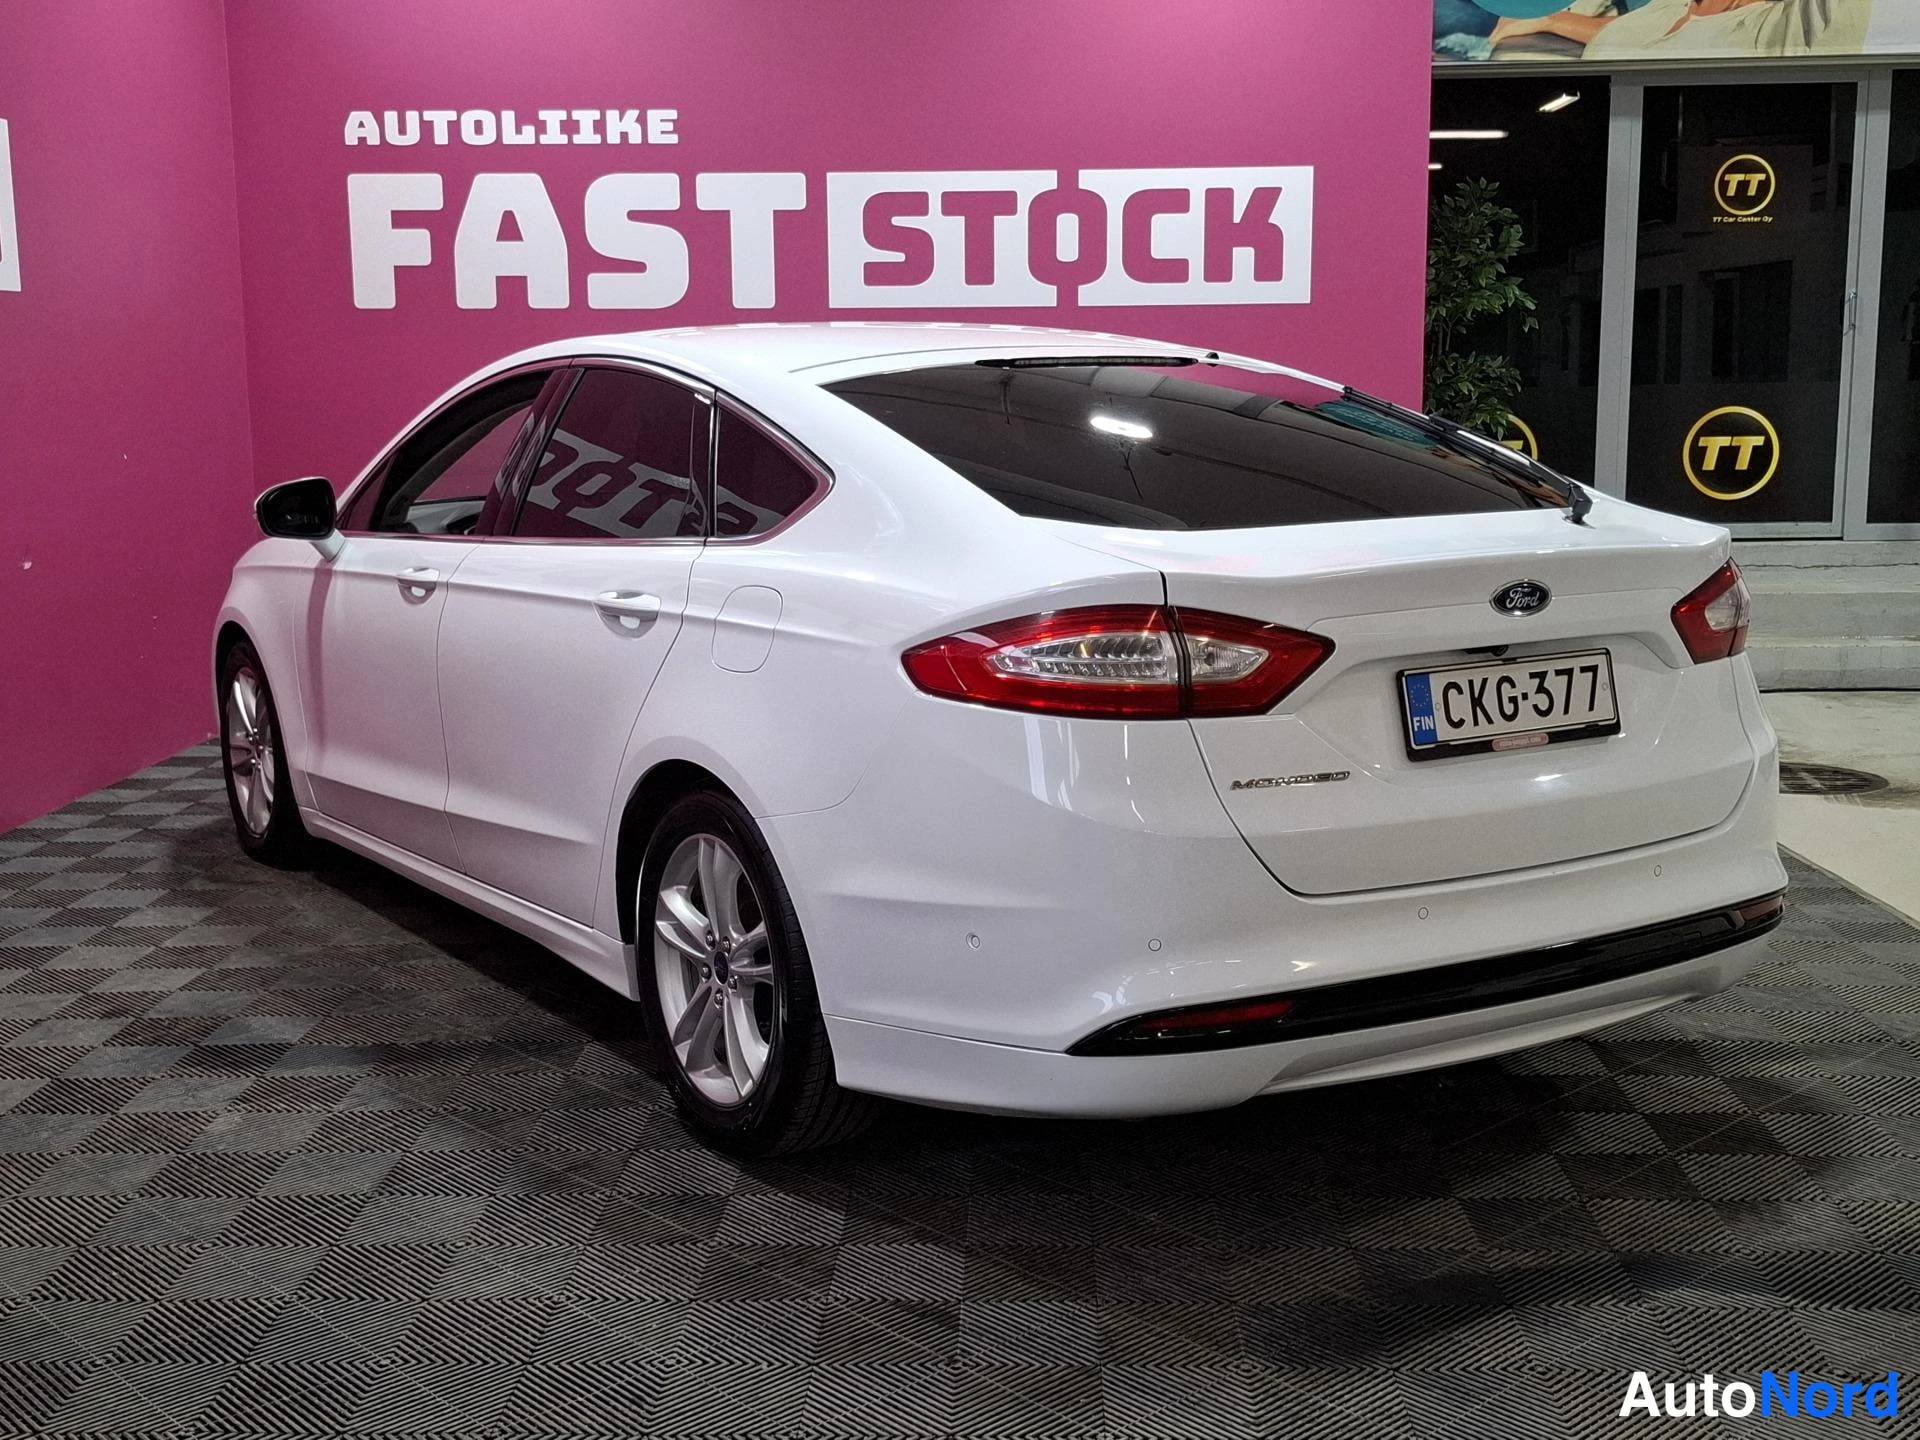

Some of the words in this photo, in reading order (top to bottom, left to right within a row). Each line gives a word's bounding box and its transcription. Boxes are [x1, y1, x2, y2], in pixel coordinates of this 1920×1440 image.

[344, 109, 679, 146] AUTOLIIKE
[1724, 173, 1766, 196] TT
[347, 172, 807, 310] FAST
[862, 186, 1284, 287] STOCK
[1697, 436, 1766, 471] TT
[1506, 587, 1540, 609] Ford
[1442, 664, 1599, 730] CKG-377
[1413, 715, 1434, 732] FIN
[1230, 770, 1350, 790] MONDEO
